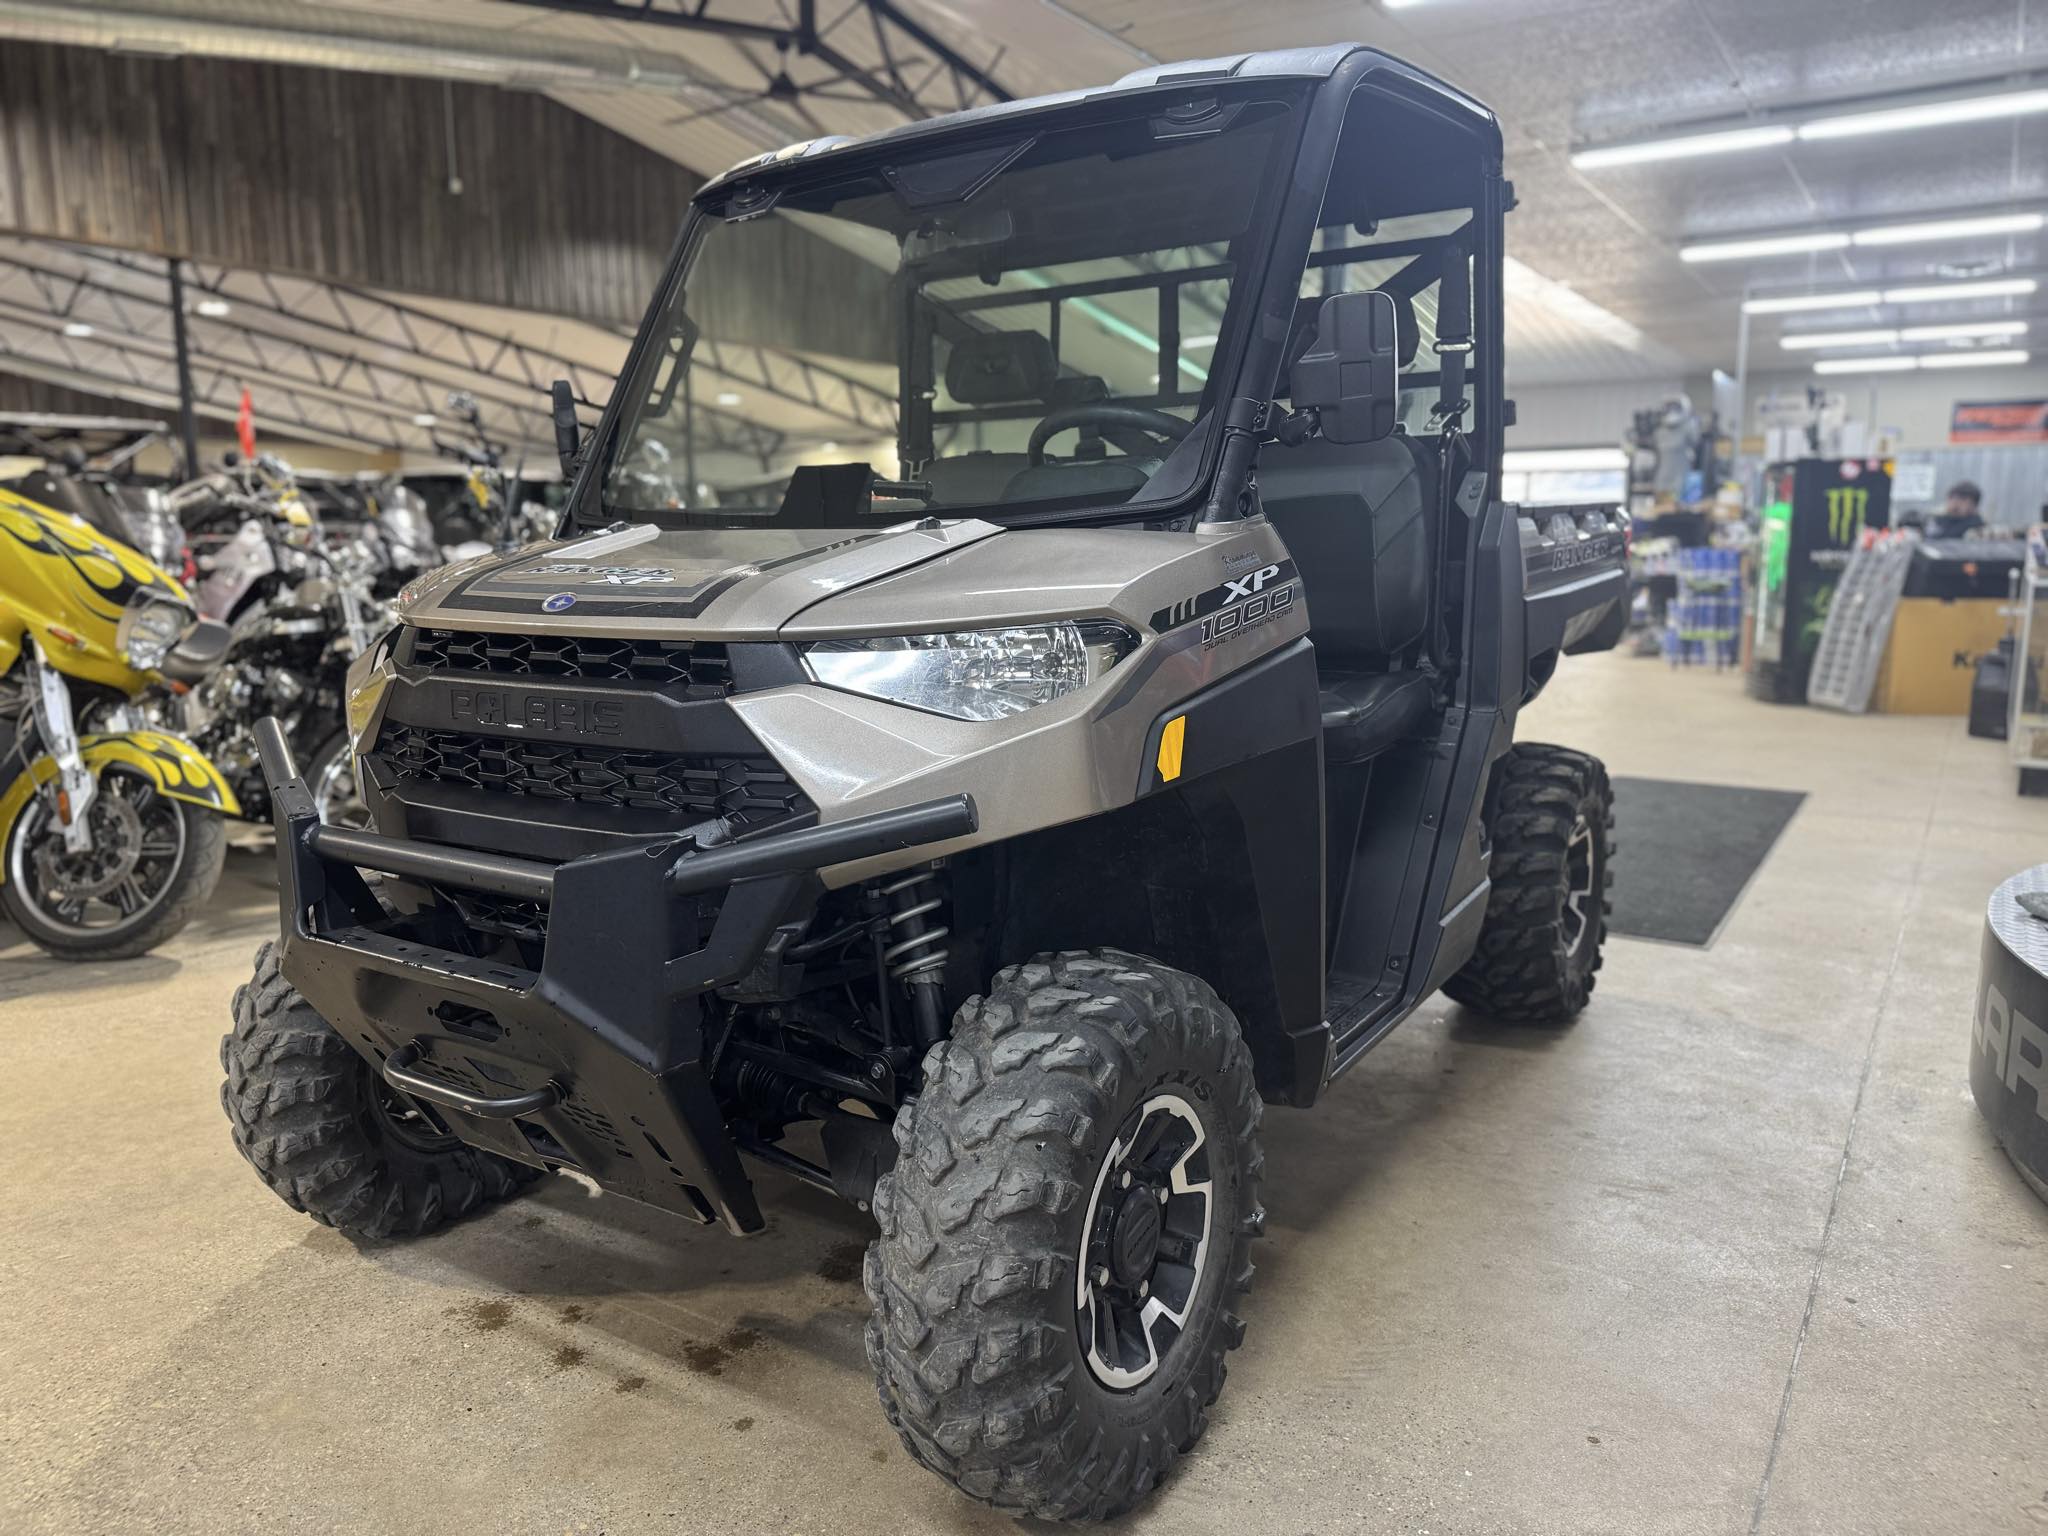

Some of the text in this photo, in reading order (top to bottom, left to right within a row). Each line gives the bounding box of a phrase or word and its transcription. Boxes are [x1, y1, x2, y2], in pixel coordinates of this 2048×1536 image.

[1552, 536, 1608, 571] RANGER
[1223, 565, 1279, 605] XP
[1201, 584, 1295, 645] 1000
[451, 689, 623, 737] POLARIS
